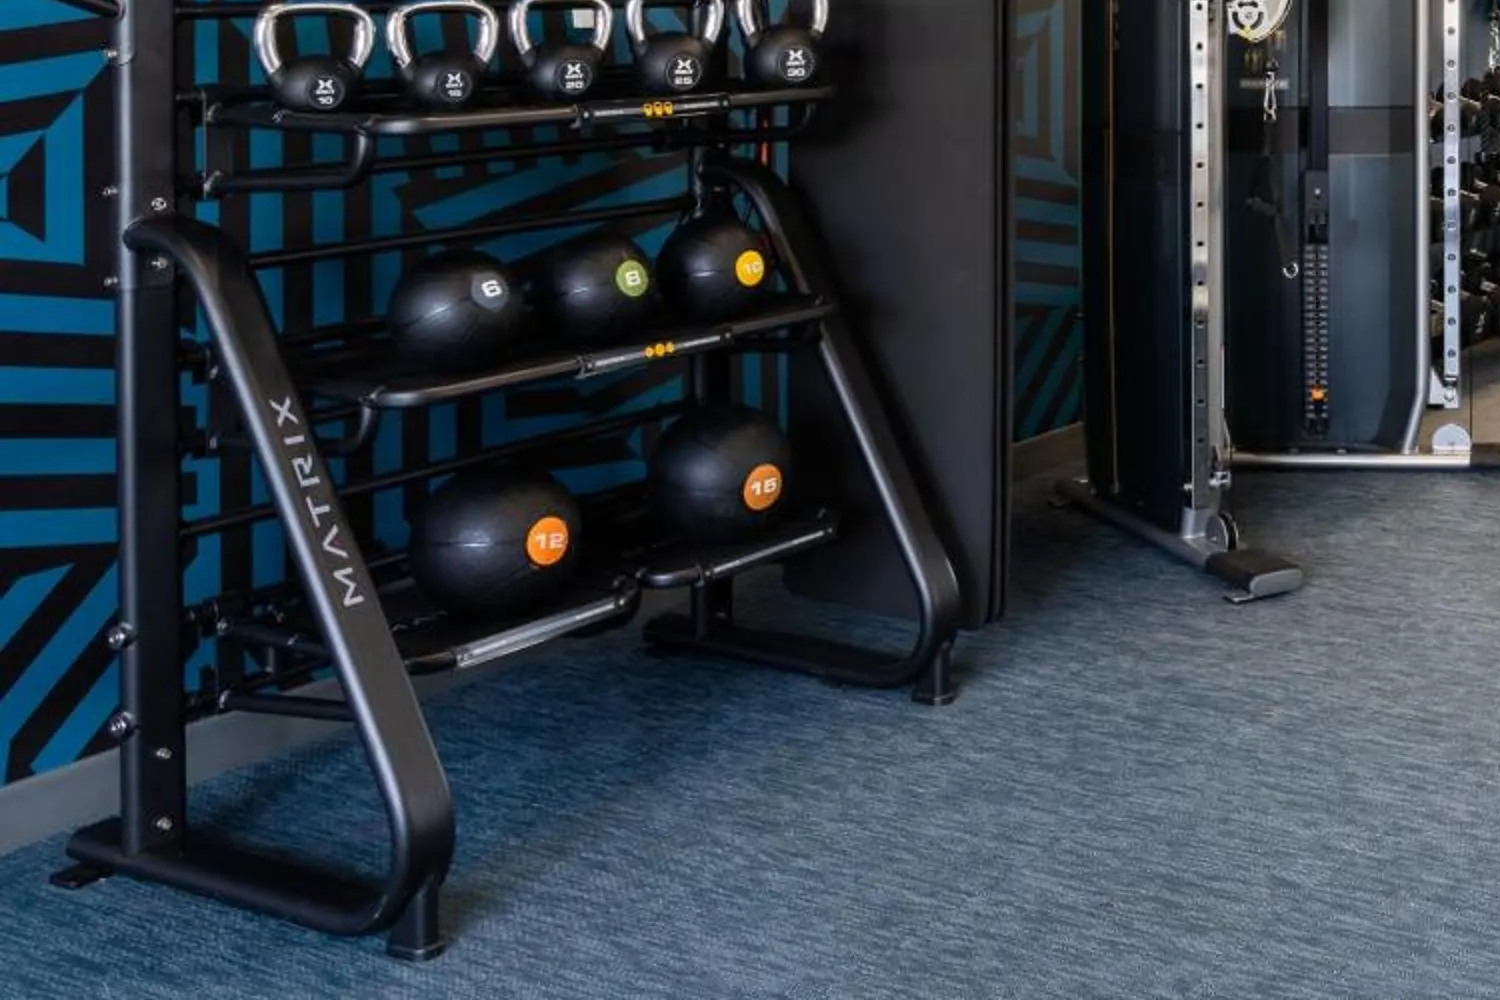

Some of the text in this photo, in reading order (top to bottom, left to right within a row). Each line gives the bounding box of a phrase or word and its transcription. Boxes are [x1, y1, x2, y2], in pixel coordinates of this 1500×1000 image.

[787, 68, 805, 76] 30
[565, 81, 583, 89] 20
[318, 96, 333, 104] 10
[481, 280, 503, 298] 6
[269, 396, 365, 607] MATRIX
[535, 532, 565, 549] 12
